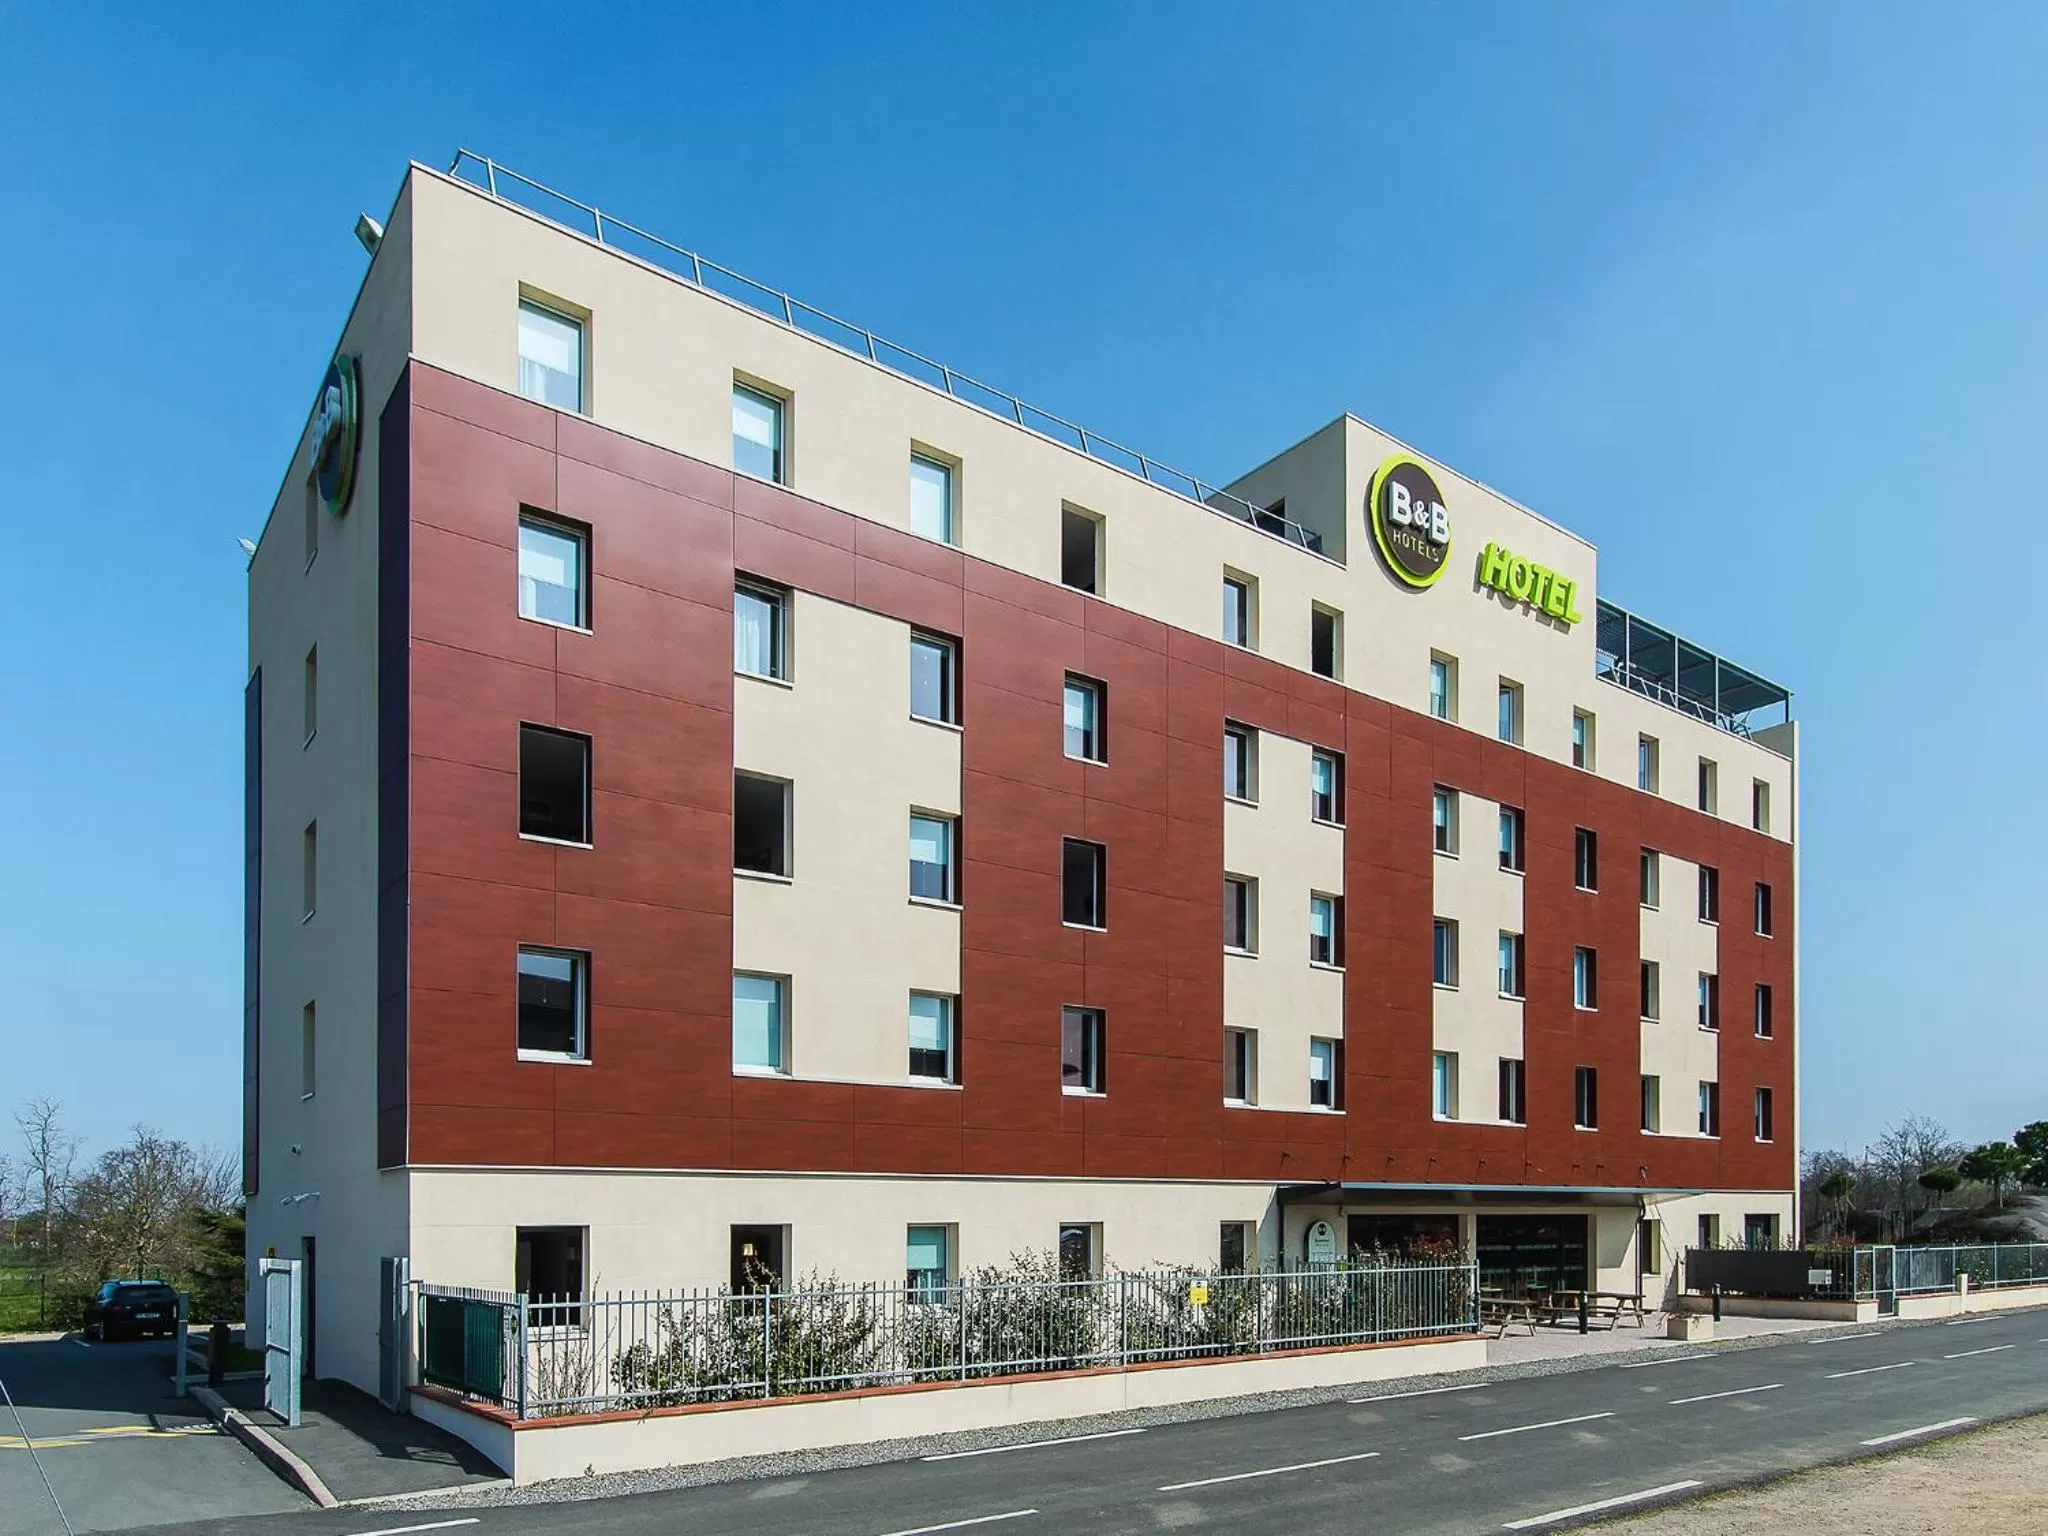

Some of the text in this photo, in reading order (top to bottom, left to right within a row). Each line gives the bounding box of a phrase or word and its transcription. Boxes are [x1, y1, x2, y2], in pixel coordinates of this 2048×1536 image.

[1389, 481, 1449, 544] B&B
[1392, 529, 1439, 562] HOTELS
[1479, 541, 1582, 625] HOTEL
